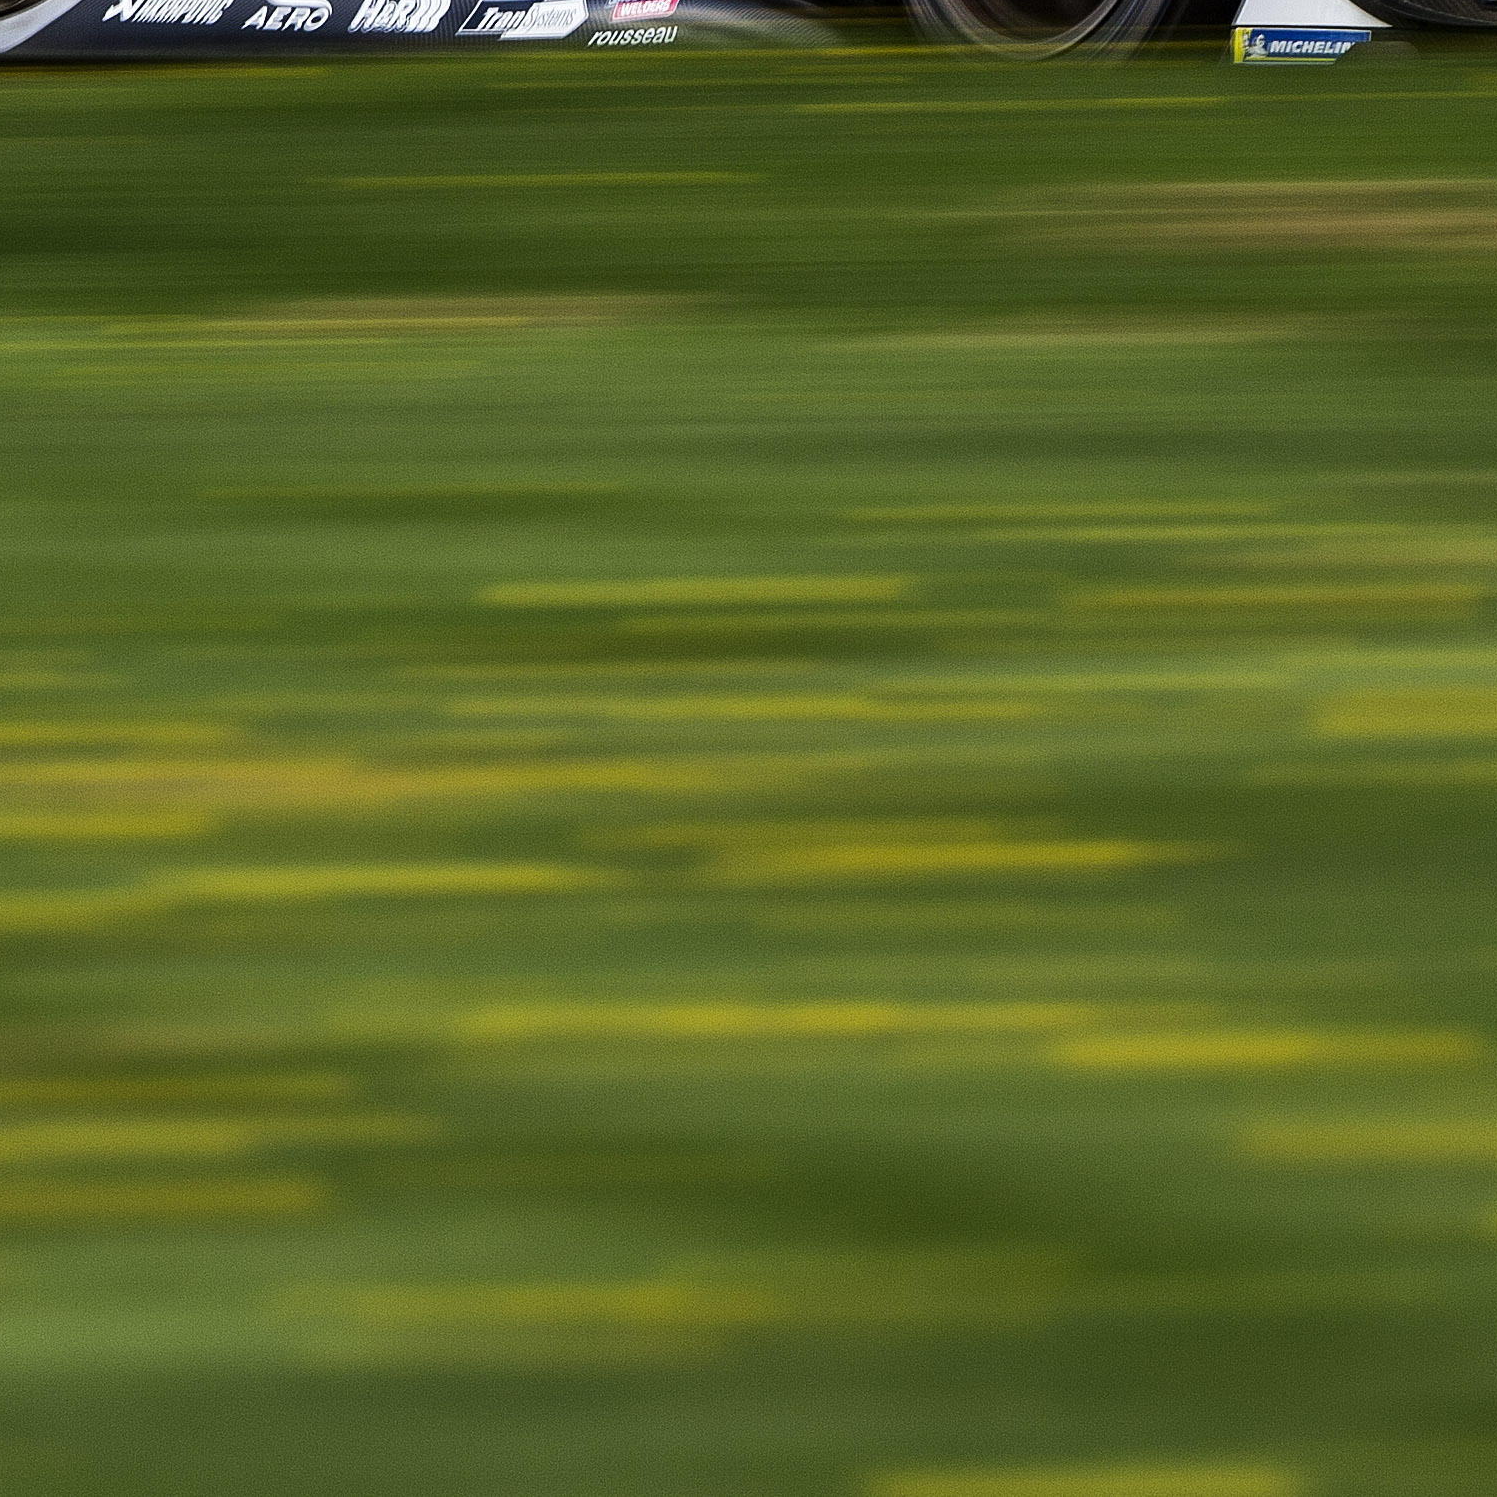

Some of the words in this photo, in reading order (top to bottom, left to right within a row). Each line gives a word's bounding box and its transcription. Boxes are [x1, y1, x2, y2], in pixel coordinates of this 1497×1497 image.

[241, 5, 330, 32] AERO
[618, 0, 672, 17] WELDERS
[587, 25, 679, 48] rousseau
